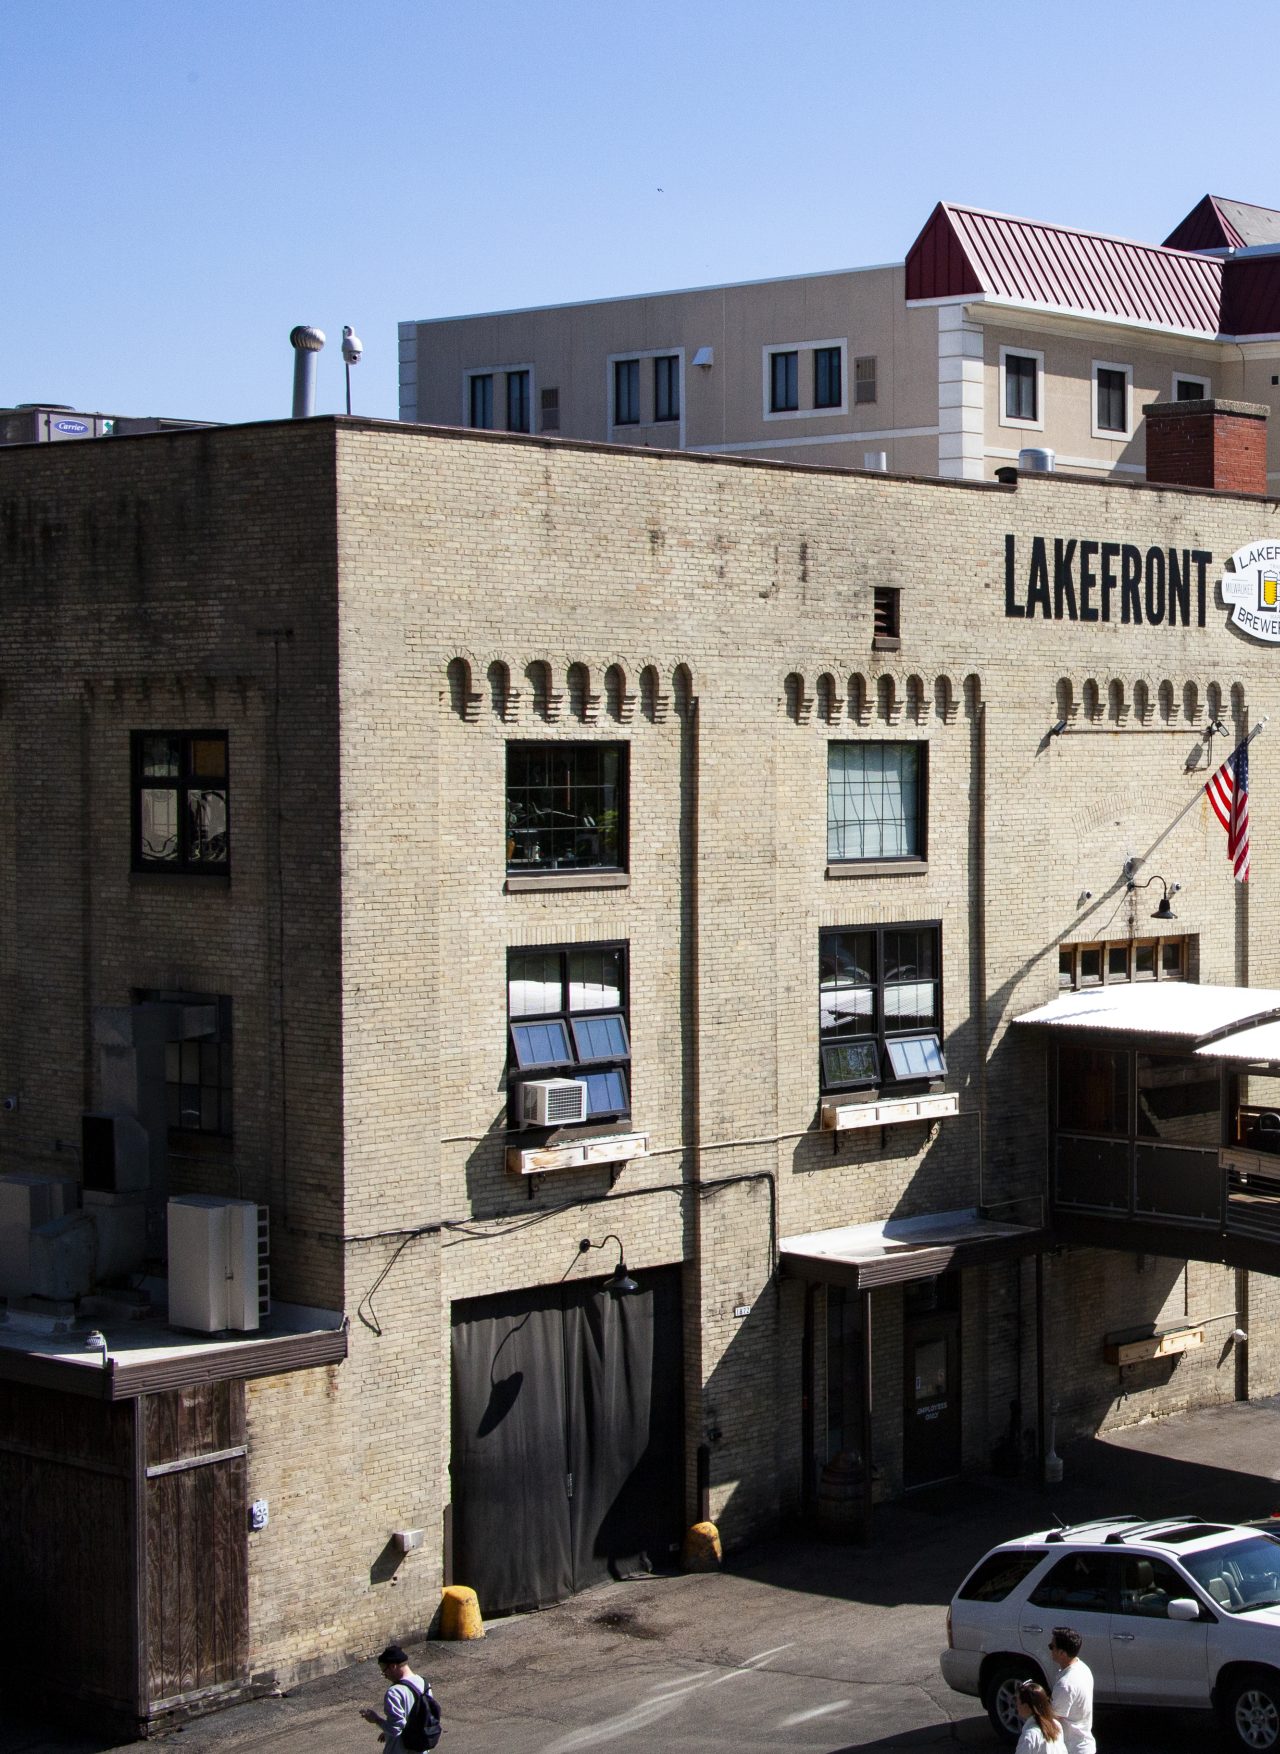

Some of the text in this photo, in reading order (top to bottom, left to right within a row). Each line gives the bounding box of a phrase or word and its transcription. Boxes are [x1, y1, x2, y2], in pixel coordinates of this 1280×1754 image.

[58, 422, 85, 431] Carrier
[1004, 534, 1213, 628] LAKEFRONT
[1225, 583, 1254, 595] MILWAUKEE
